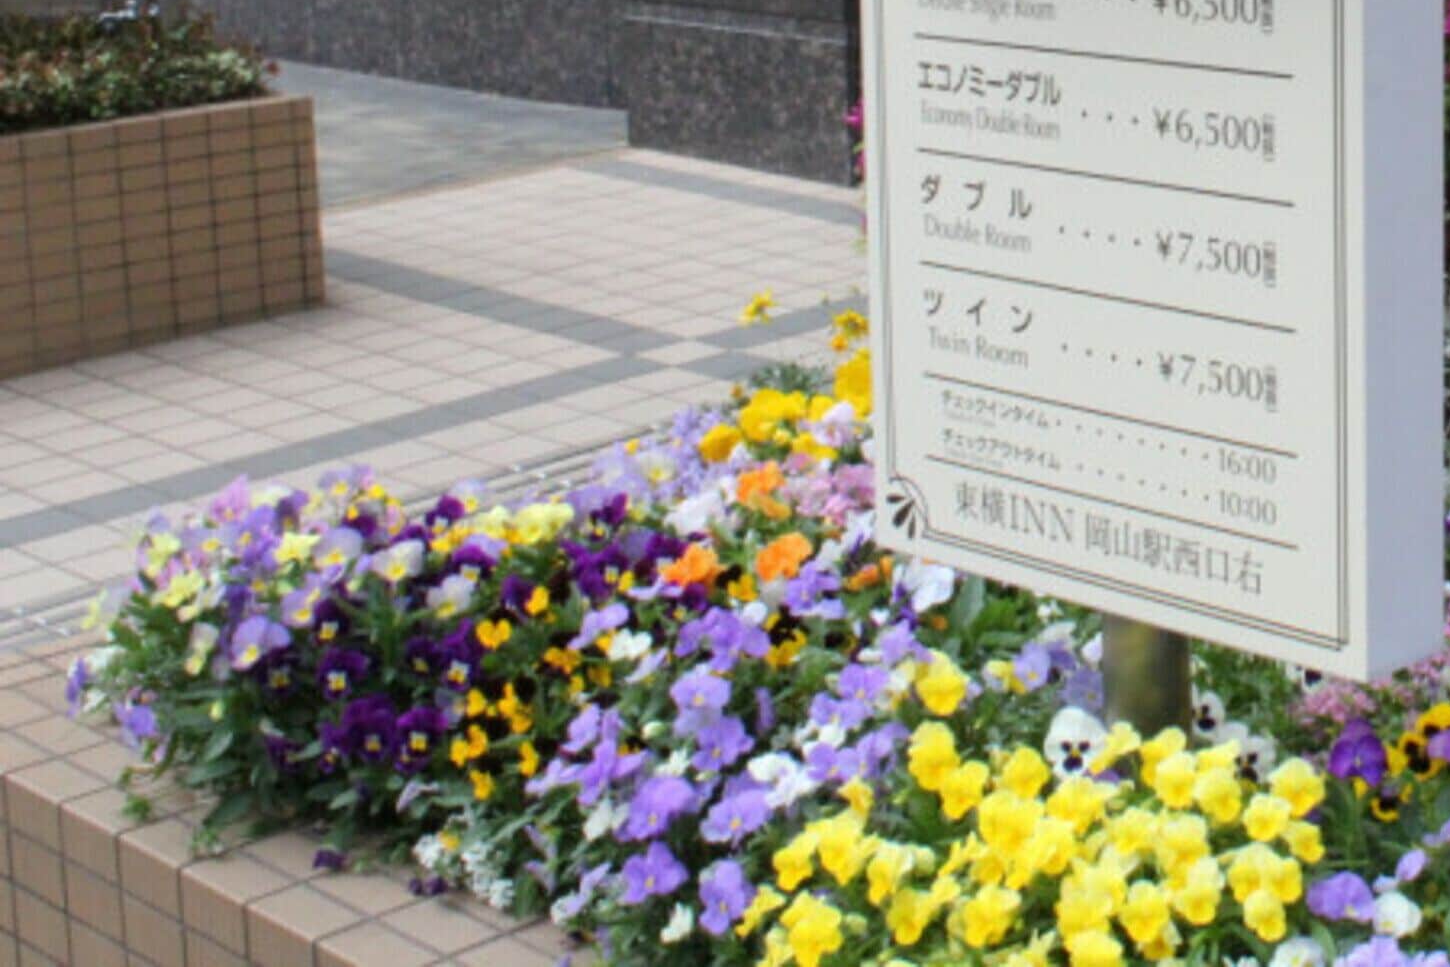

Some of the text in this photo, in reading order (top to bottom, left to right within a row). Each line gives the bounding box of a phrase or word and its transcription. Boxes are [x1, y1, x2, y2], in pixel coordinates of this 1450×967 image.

[917, 61, 1061, 106] エコノミーダブル
[1154, 109, 1261, 153] ¥6,500
[920, 174, 1032, 220] ダブル
[923, 212, 1032, 252] Double Room
[1156, 230, 1262, 277] ¥7,500
[923, 288, 1032, 334] ツイン
[928, 325, 1029, 369] Twin Room
[1159, 352, 1263, 401] ¥7,500
[1218, 447, 1277, 483] 16:00
[1218, 488, 1278, 526] 10:00
[955, 481, 1264, 594] 東横INN 岡山駅西口右
